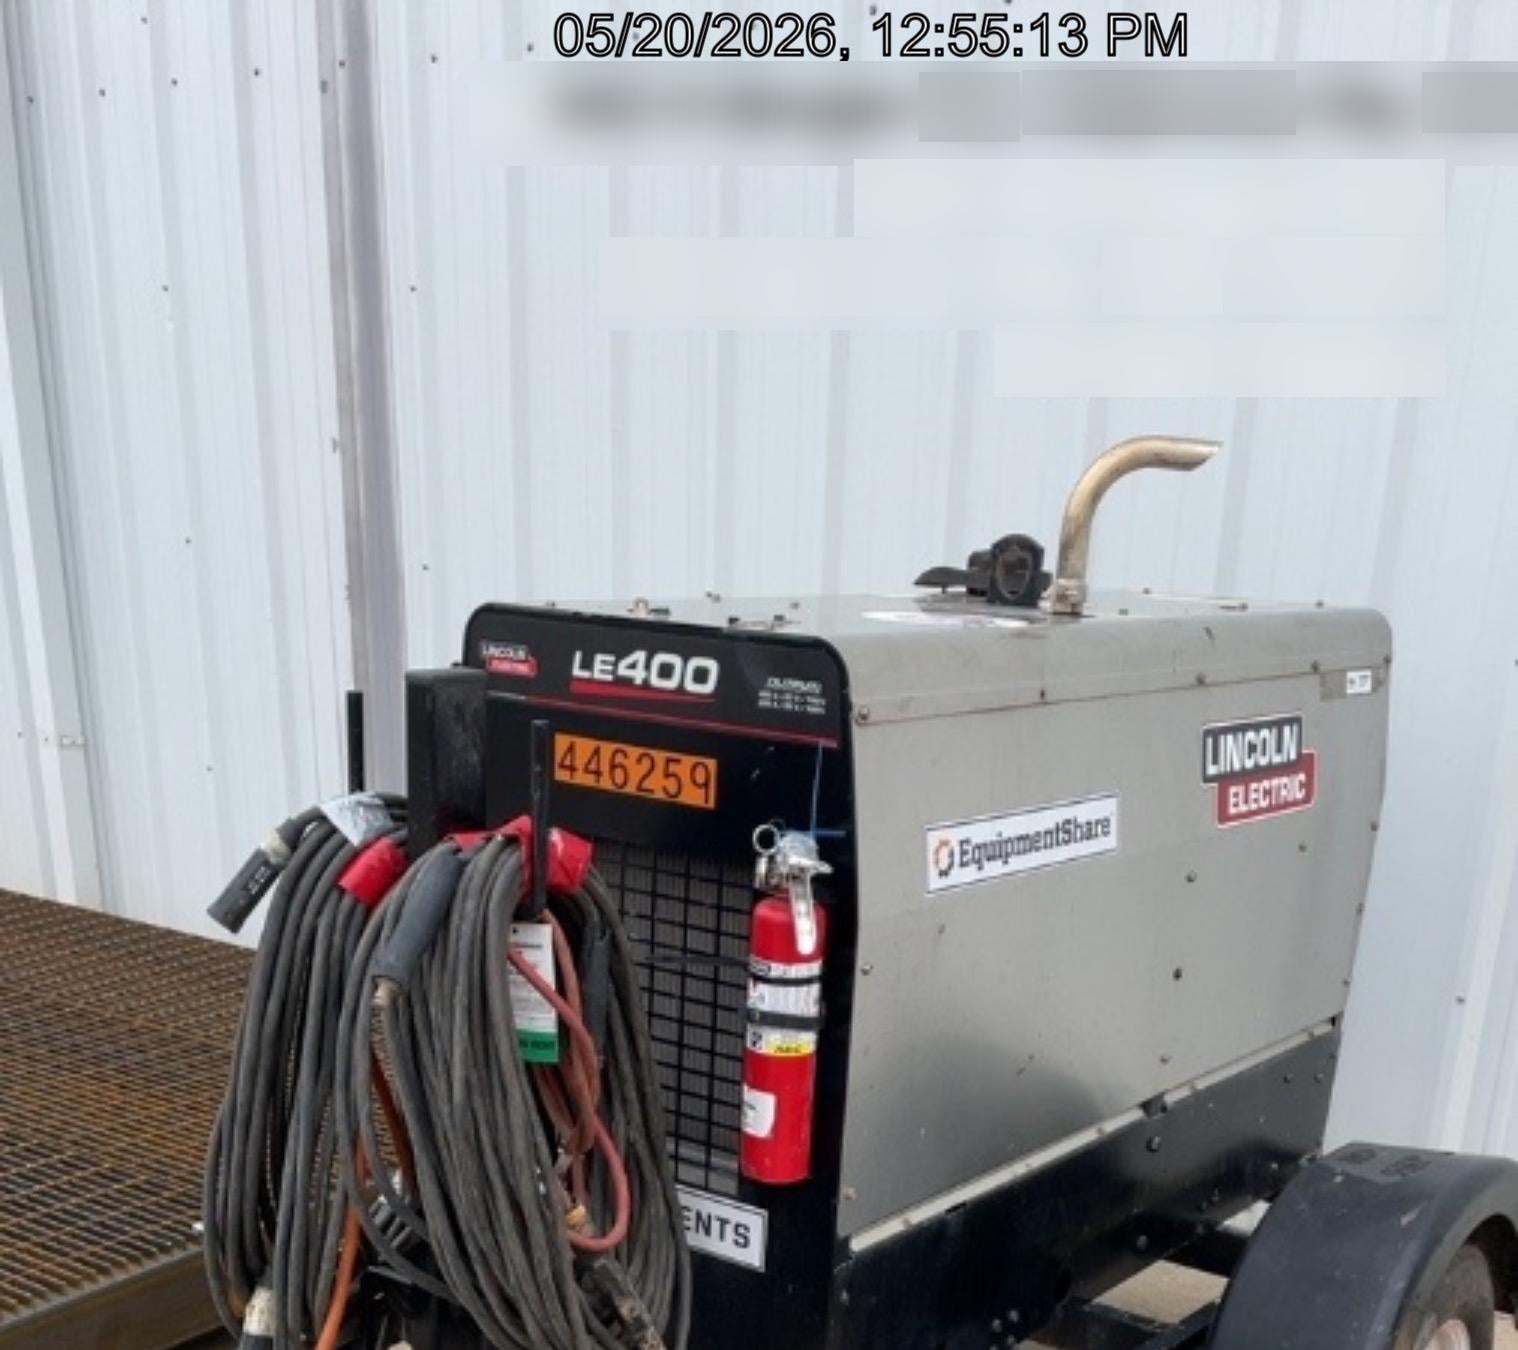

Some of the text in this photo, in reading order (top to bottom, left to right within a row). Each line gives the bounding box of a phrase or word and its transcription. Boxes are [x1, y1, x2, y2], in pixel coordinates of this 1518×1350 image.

[572, 650, 719, 695] LE400
[558, 740, 712, 805] 446259
[1205, 722, 1299, 776] LINCOLN
[1228, 772, 1307, 815] ELECTRIC
[959, 816, 1112, 872] EquipmentShare
